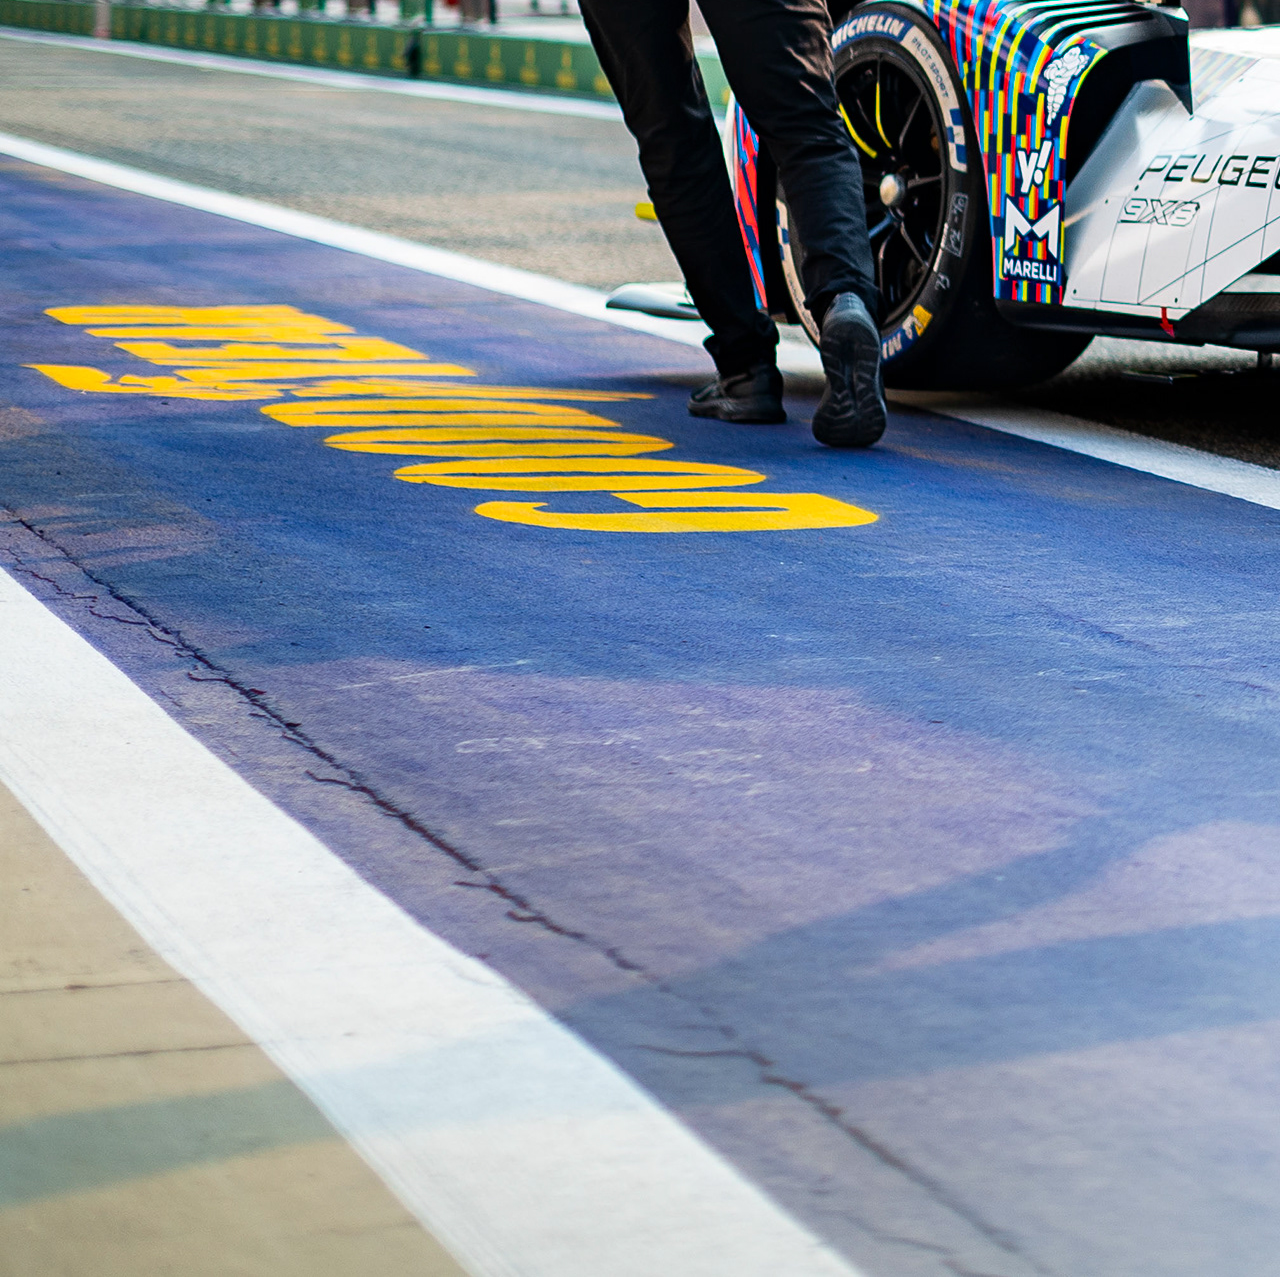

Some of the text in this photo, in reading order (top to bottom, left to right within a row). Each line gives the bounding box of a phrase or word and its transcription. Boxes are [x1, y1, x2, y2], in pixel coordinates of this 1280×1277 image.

[831, 14, 905, 50] MICHELIN
[911, 36, 950, 98] PILOT SPORT
[1121, 197, 1201, 227] 9X8
[1003, 257, 1057, 282] MARELLI
